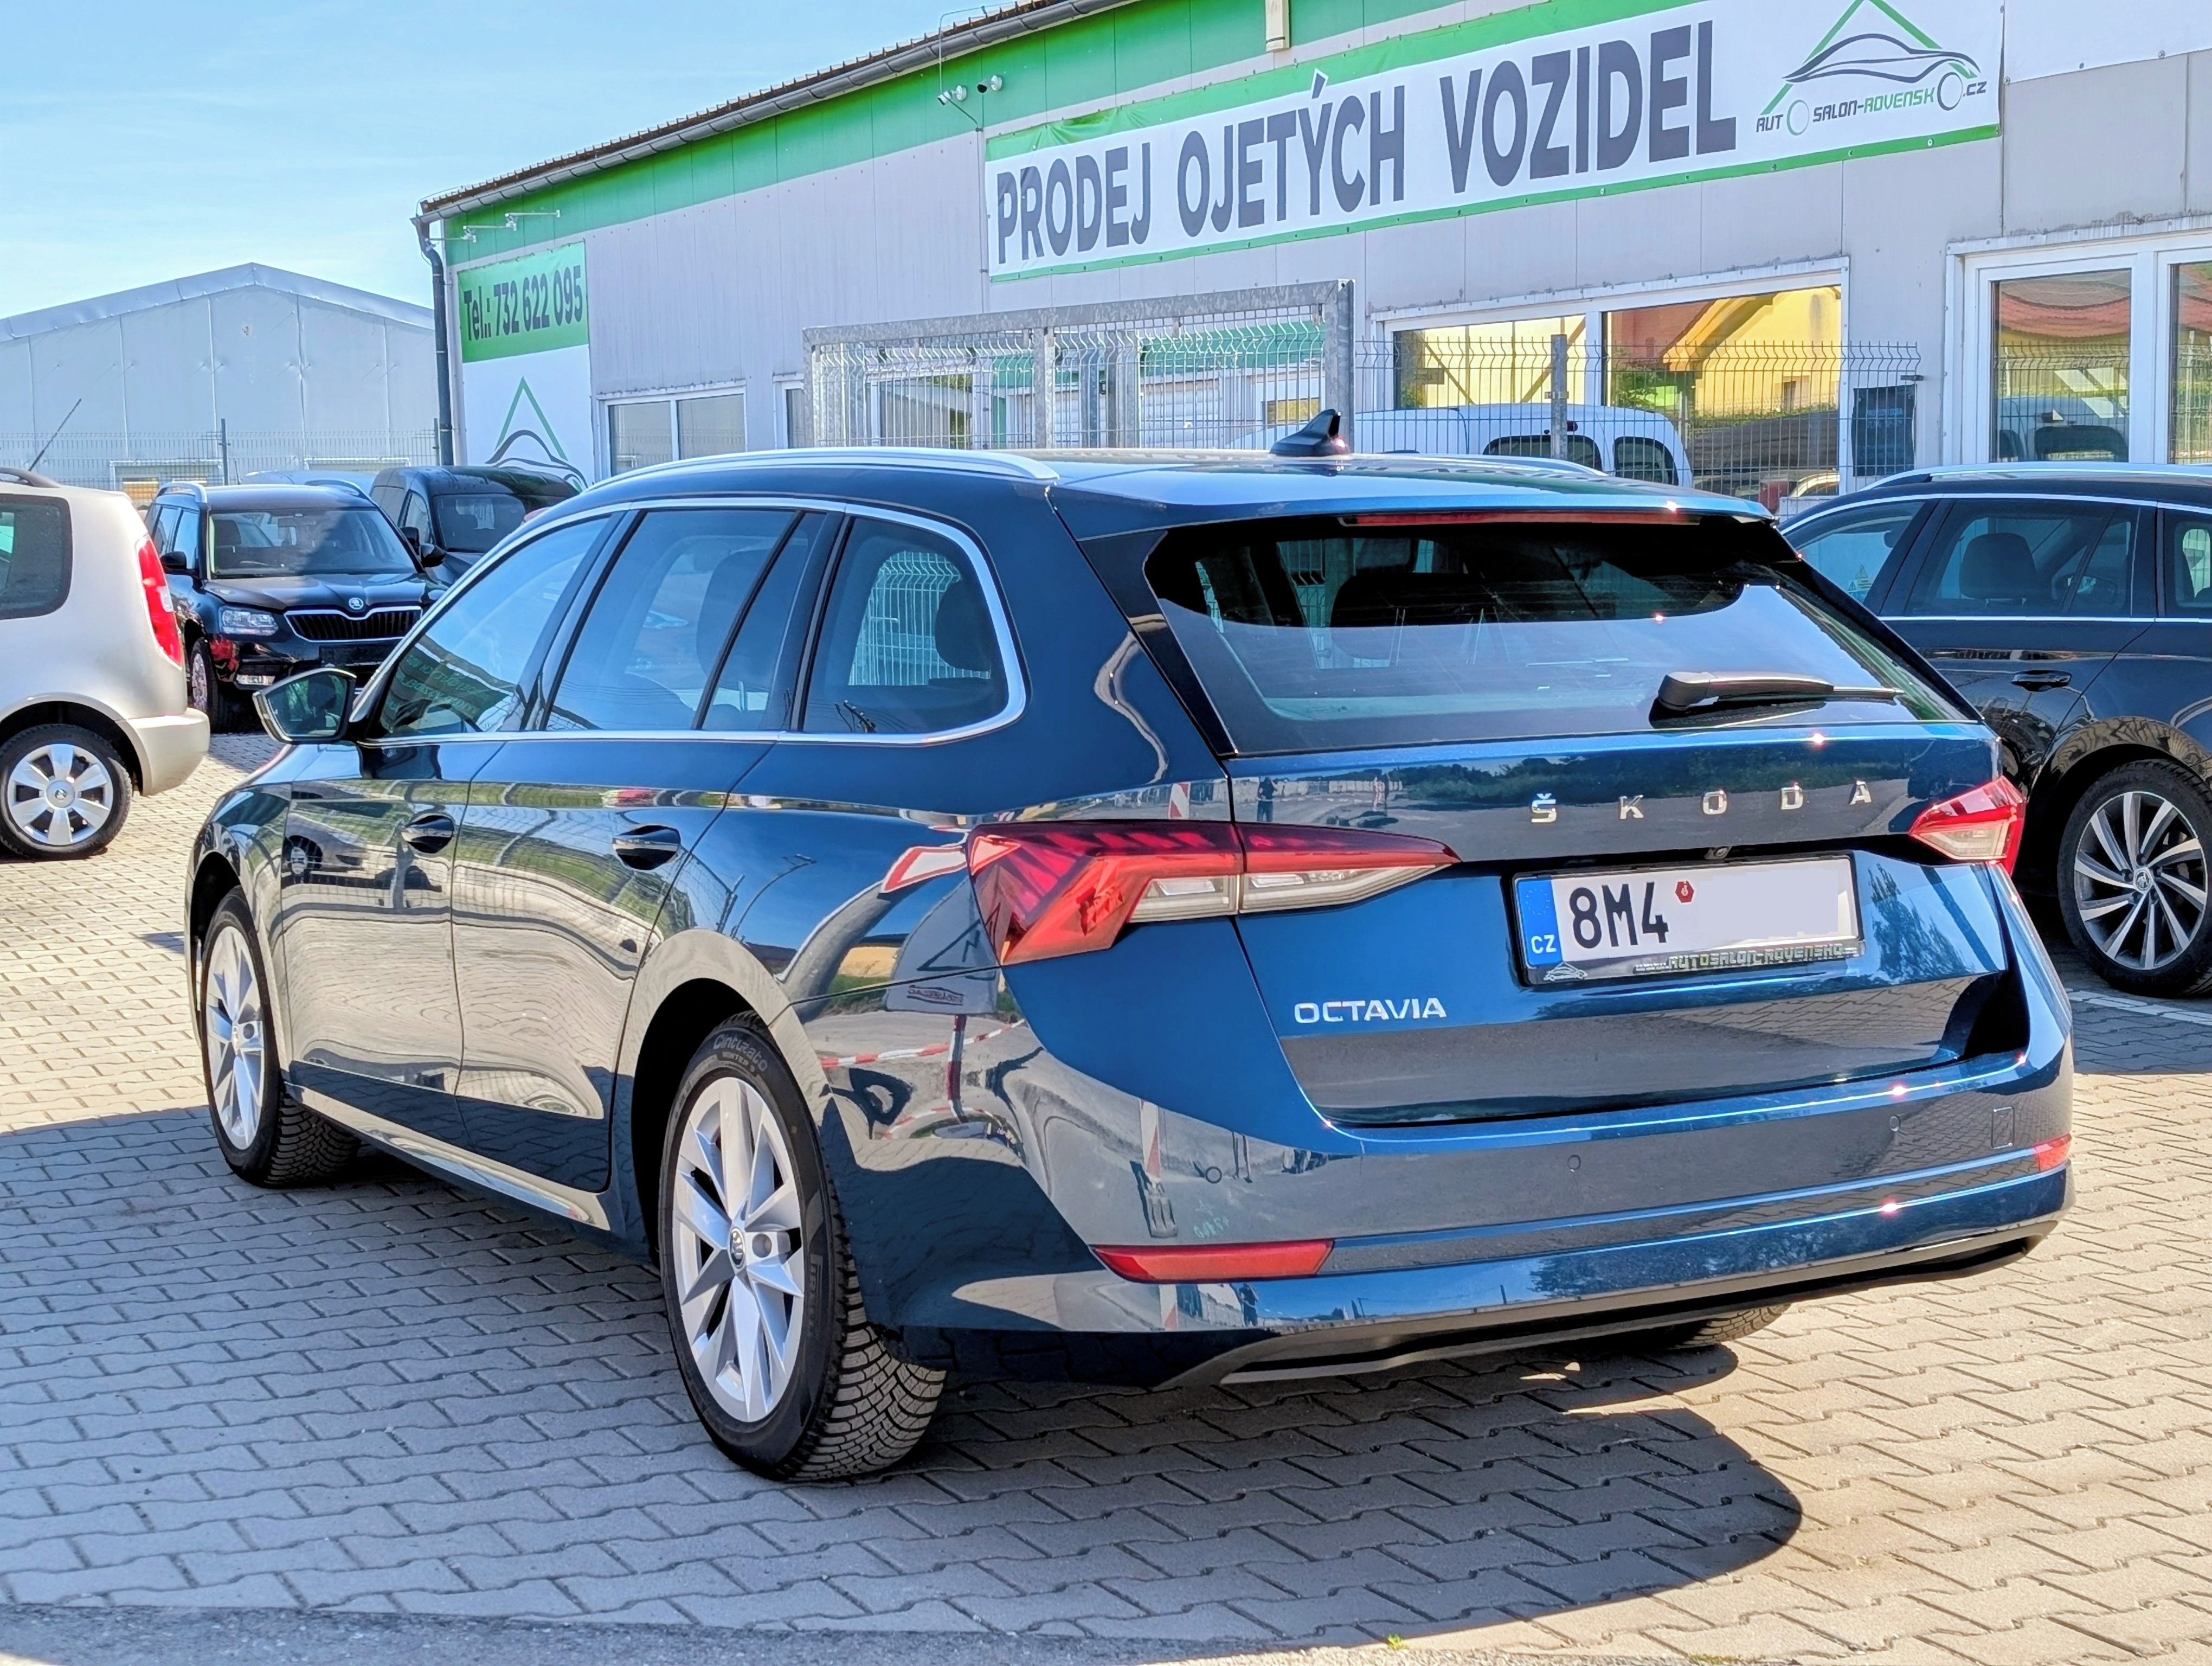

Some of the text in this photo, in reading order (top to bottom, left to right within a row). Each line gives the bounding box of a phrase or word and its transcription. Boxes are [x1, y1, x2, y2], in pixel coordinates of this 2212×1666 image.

[996, 20, 1737, 264] PRODEJ OJETÝCH VOZIDEL
[464, 265, 583, 341] Tel.: 732 622 095
[1531, 780, 1872, 823] ŠKODA
[1569, 880, 1669, 949] 8M4
[1531, 934, 1557, 954] CZ
[1294, 997, 1447, 1024] OCTAVIA
